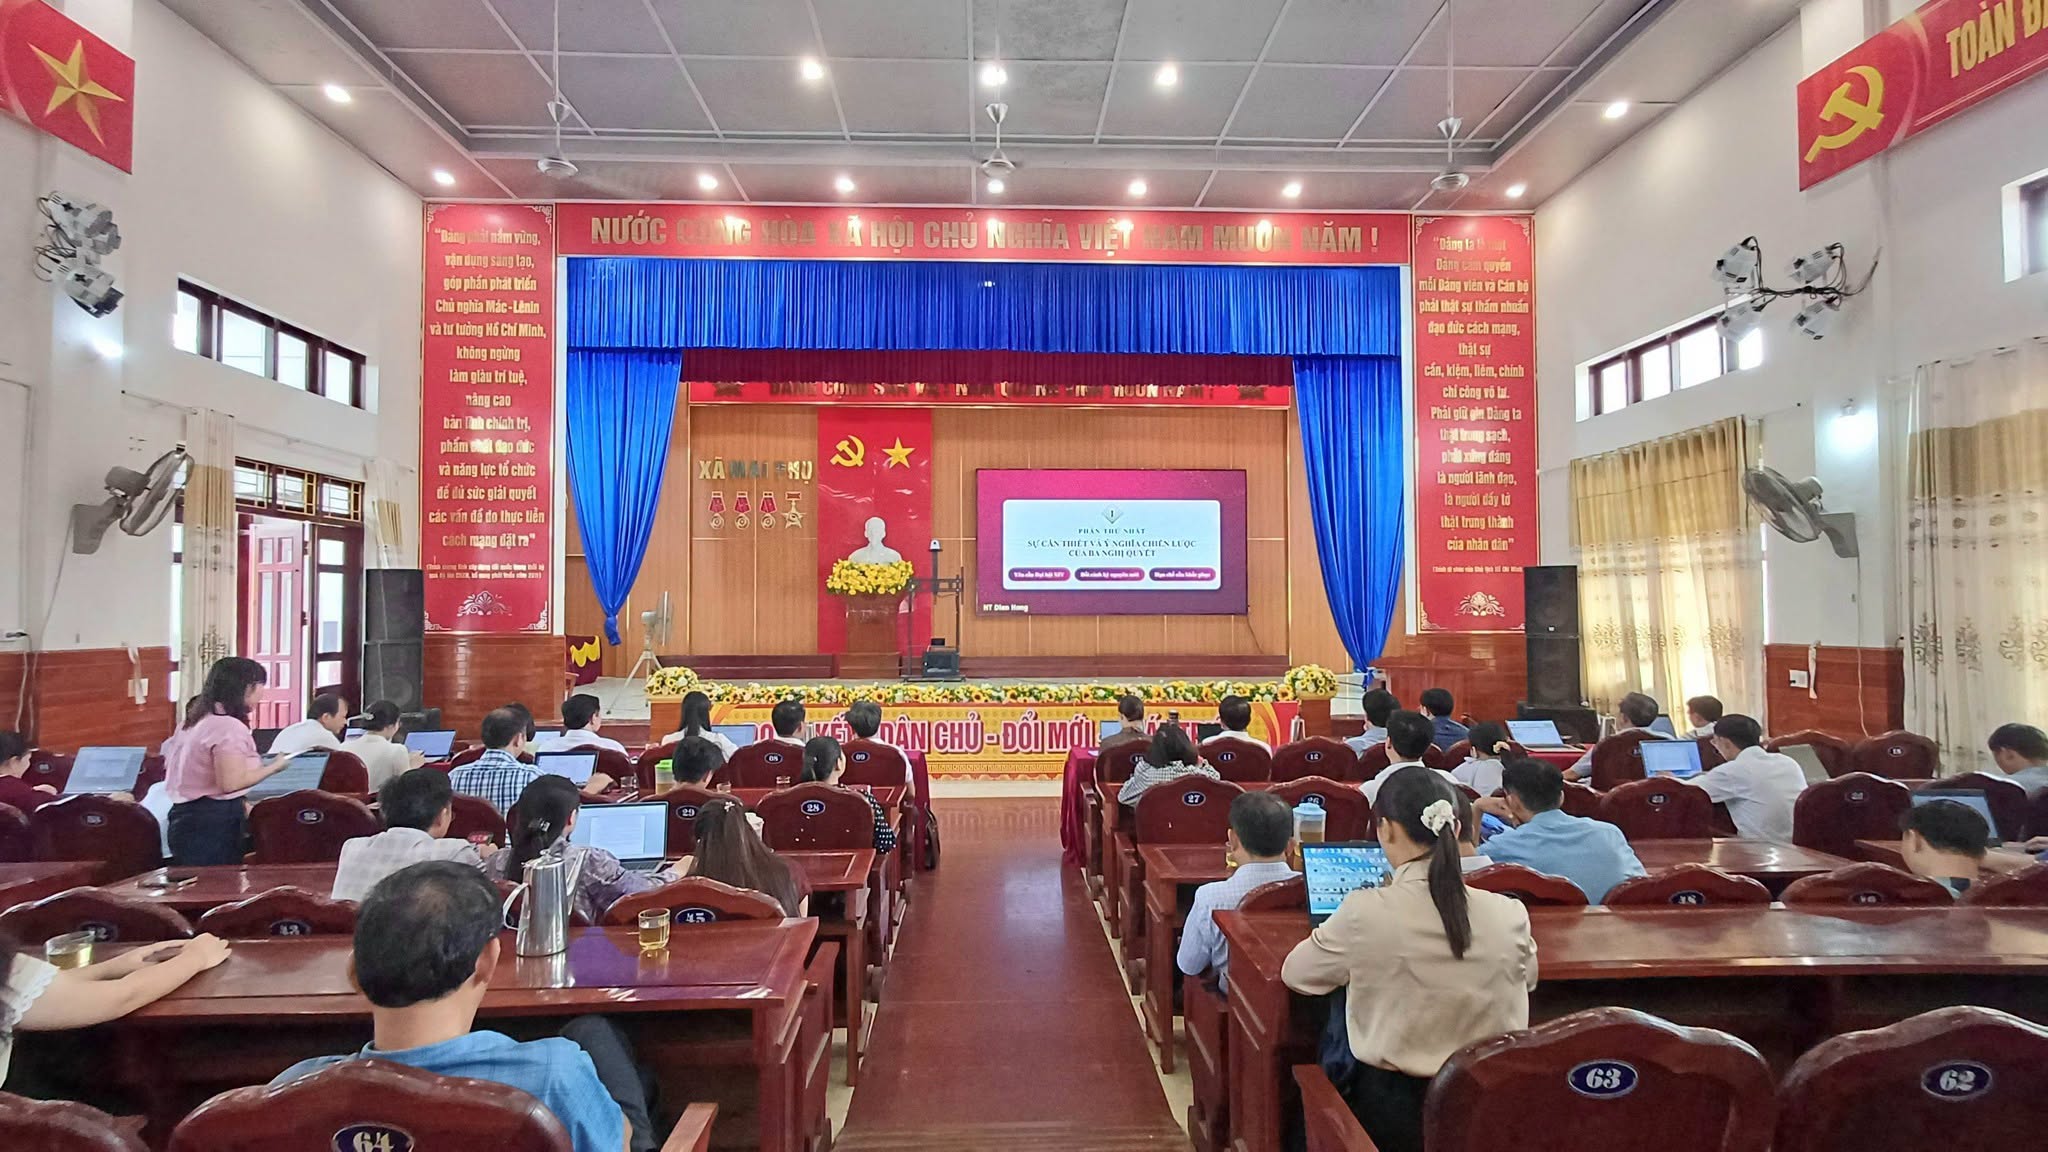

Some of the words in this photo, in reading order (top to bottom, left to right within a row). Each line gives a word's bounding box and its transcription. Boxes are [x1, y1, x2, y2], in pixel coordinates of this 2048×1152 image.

[591, 209, 667, 245] NƯỚC
[828, 213, 862, 247] XÃ
[871, 215, 913, 254] HỘI
[924, 211, 977, 249] CHỦ
[987, 218, 1070, 249] NGHĨA
[1078, 218, 1134, 256] VIỆT
[1144, 224, 1203, 250] NAM
[1213, 219, 1292, 251] MUÔN
[1303, 220, 1361, 253] NĂM
[1466, 238, 1473, 250] ta
[445, 254, 461, 268] vận
[517, 254, 534, 270] tạo,
[444, 277, 461, 291] góp
[490, 277, 512, 291] phát
[1419, 275, 1436, 291] mỗi
[1439, 278, 1461, 293] Đảng
[1464, 279, 1482, 292] viên
[1485, 279, 1495, 291] và
[1498, 278, 1514, 292] Cán
[1517, 279, 1528, 295] bộ
[436, 298, 454, 313] Chủ
[457, 300, 483, 314] nghĩa
[1419, 300, 1438, 314] phải
[1441, 301, 1459, 314] thật
[1462, 302, 1473, 315] sự
[1475, 298, 1498, 313] thấm
[430, 323, 441, 336] và
[444, 323, 453, 335] tư
[456, 322, 483, 336] tưởng
[486, 322, 499, 336] Hồ
[501, 322, 516, 336] Chí
[519, 323, 546, 338] Minh,
[1428, 321, 1444, 336] đạo
[1448, 320, 1464, 334] đức
[1467, 321, 1489, 334] cách
[1492, 323, 1520, 336] mạng,
[456, 346, 487, 361] không
[490, 346, 520, 361] ngừng
[1459, 342, 1477, 357] thật
[1480, 344, 1491, 359] sự
[450, 369, 468, 383] làm
[471, 369, 492, 384] giàu
[494, 370, 506, 383] trí
[508, 370, 527, 385] tuệ,
[1446, 364, 1472, 379] kiệm,
[1475, 364, 1497, 378] liêm,
[1499, 364, 1524, 377] chính
[1443, 385, 1457, 398] chí
[1459, 385, 1481, 400] công
[1484, 386, 1495, 398] vô
[465, 394, 490, 408] nâng
[493, 395, 510, 406] cao
[1431, 405, 1450, 420] Phải
[1454, 405, 1467, 421] giữ
[1487, 406, 1509, 421] Đảng
[1512, 408, 1521, 420] ta
[444, 415, 462, 430] bản
[486, 415, 514, 430] chính
[517, 416, 530, 432] trị,
[1486, 429, 1510, 444] sạch,
[441, 438, 468, 453] phẩm
[1489, 450, 1510, 464] đáng
[439, 462, 450, 475] và
[453, 463, 477, 477] năng
[481, 463, 496, 478] lực
[499, 460, 509, 475] tổ
[511, 462, 535, 476] chức
[699, 457, 725, 479] XÃ
[1438, 472, 1446, 484] là
[1449, 470, 1473, 486] người
[1476, 472, 1495, 484] lãnh
[1498, 472, 1517, 488] đạo,
[467, 485, 484, 499] sức
[488, 485, 506, 501] giải
[509, 485, 536, 501] quyết
[1445, 493, 1453, 505] là
[1456, 493, 1480, 507] người
[429, 509, 447, 523] các
[486, 510, 497, 523] do
[501, 510, 523, 525] thực
[526, 507, 544, 523] tiễn
[1441, 515, 1459, 531] thật
[1462, 515, 1485, 530] trung
[1487, 515, 1513, 529] thành
[470, 535, 497, 549] mạng
[500, 534, 516, 549] đặt
[1447, 536, 1463, 550] của
[1466, 537, 1488, 550] nhân
[880, 715, 930, 751] DÂN
[933, 710, 982, 753] CHỦ
[1001, 710, 1041, 752] ĐỔI
[1049, 714, 1094, 752] MỚI
[1188, 794, 1200, 804] 27
[682, 808, 696, 817] 29
[806, 803, 820, 812] 28
[686, 912, 706, 923] 45
[1585, 1067, 1621, 1089] 63
[1938, 1068, 1974, 1092] 62
[352, 1132, 394, 1152] 64
